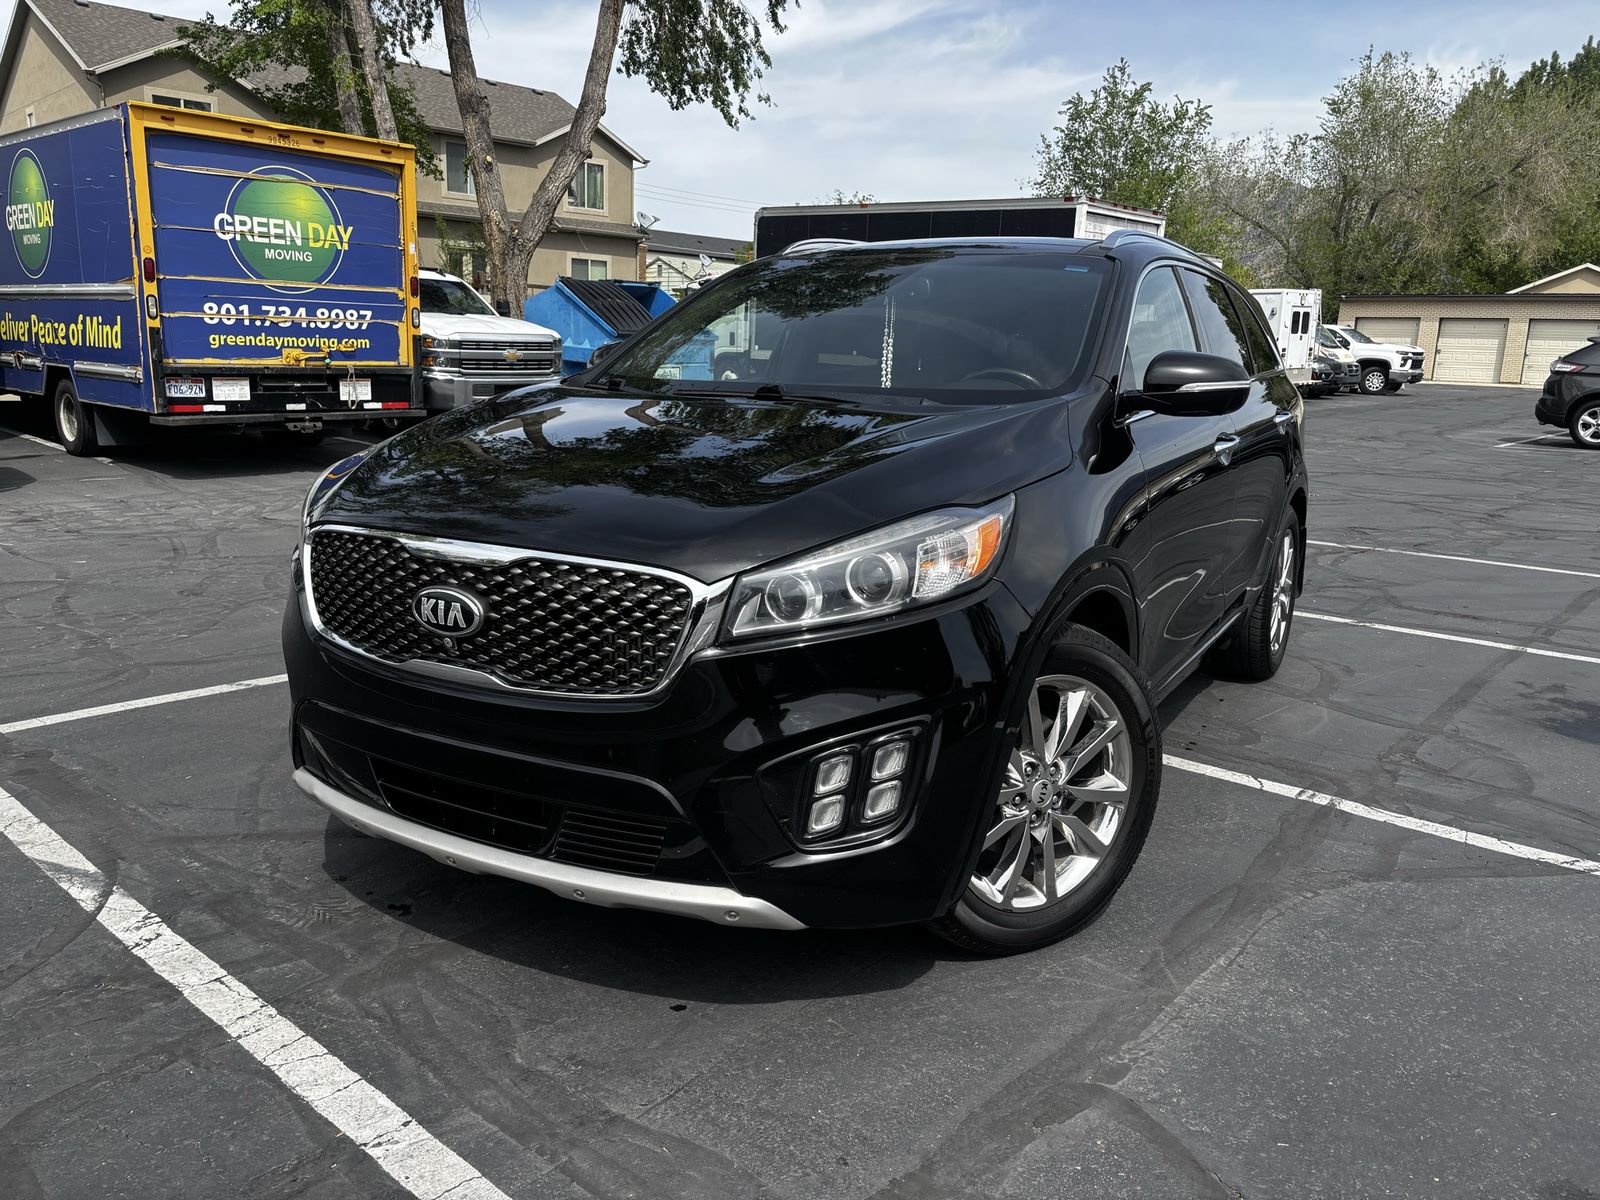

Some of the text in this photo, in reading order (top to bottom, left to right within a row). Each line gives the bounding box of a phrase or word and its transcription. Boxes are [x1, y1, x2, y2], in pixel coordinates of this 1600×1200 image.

[5, 199, 55, 231] GREEN DAY
[22, 233, 41, 245] MOVING
[213, 212, 353, 250] GREEN DAY
[264, 248, 313, 262] MOVING
[203, 302, 373, 330] 801.734.8987
[31, 314, 67, 345] Peace
[69, 314, 83, 346] of
[86, 315, 122, 349] Mind
[209, 332, 370, 351] greendaymoving.com
[421, 596, 467, 628] KIA
[1036, 783, 1049, 804] KIA
